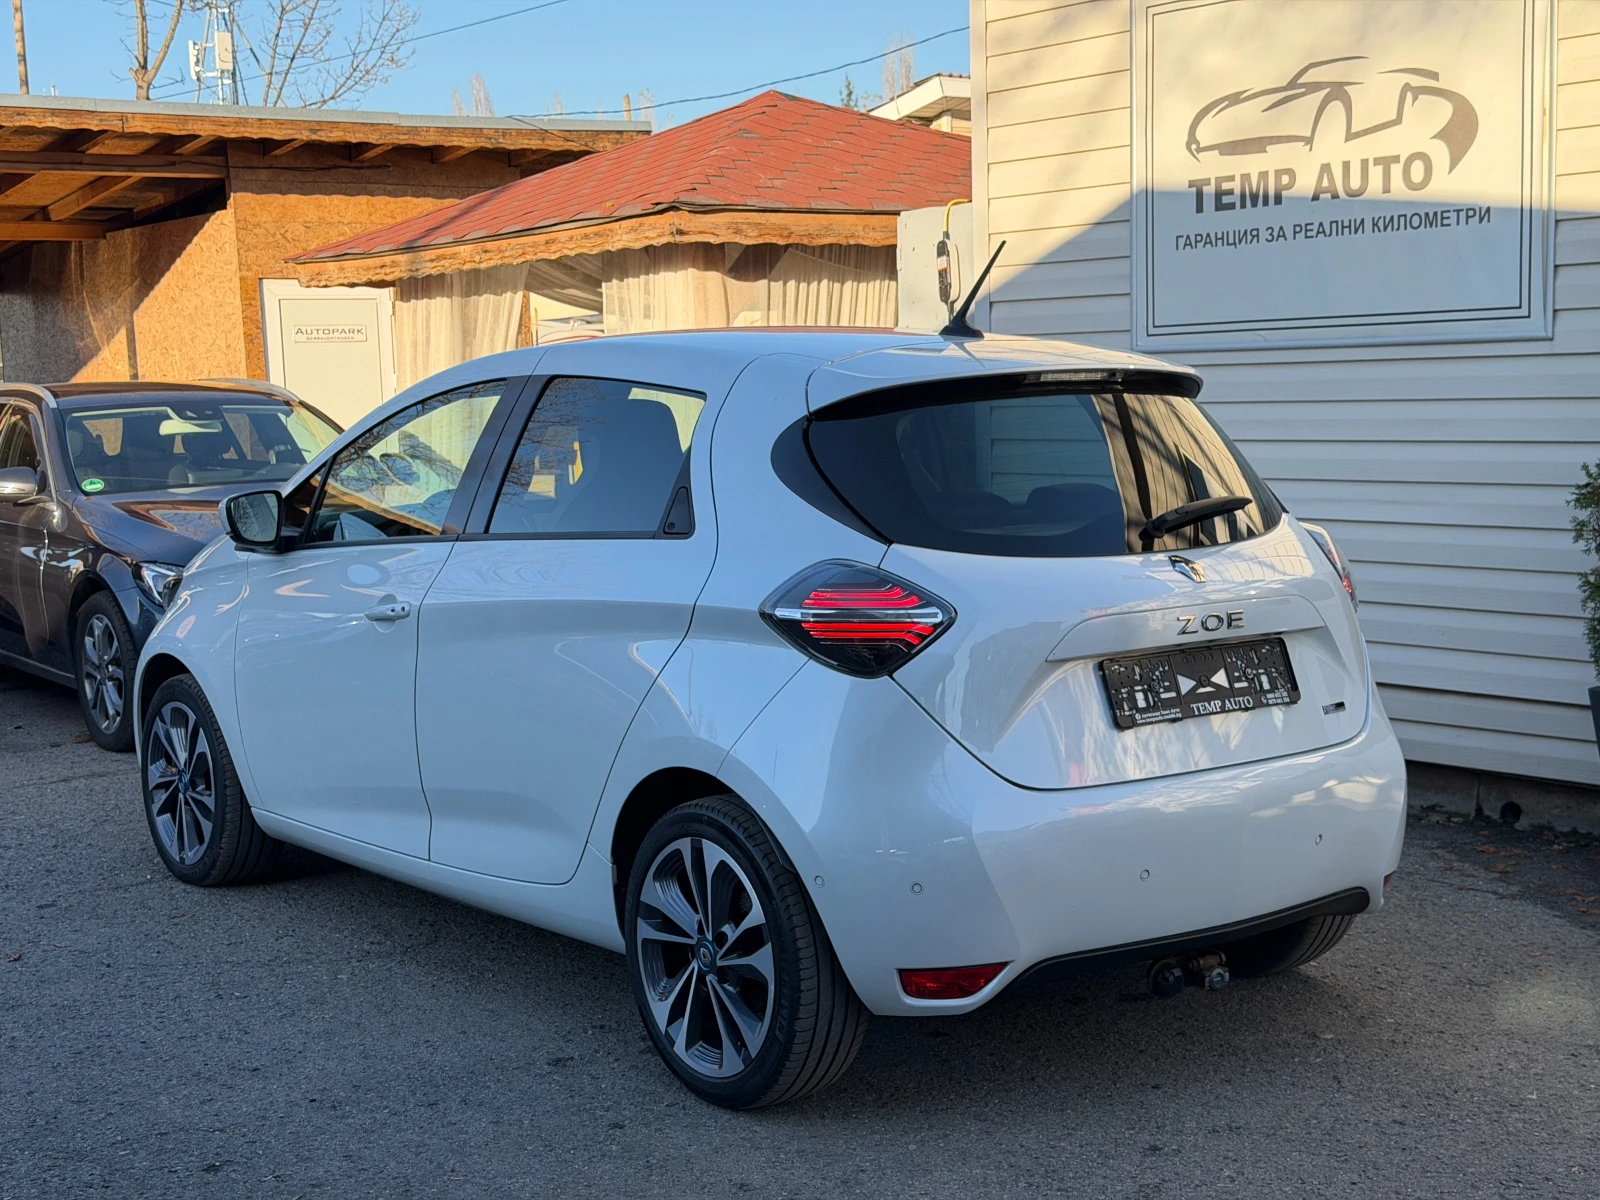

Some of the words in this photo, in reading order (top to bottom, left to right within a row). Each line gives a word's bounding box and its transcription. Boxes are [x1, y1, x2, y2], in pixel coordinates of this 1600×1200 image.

[1188, 167, 1297, 214] TEMP
[1311, 151, 1433, 202] AUTO
[1175, 227, 1260, 252] ГАРАНЦИЯ
[1265, 226, 1288, 243] ЗА
[1292, 217, 1365, 241] РЕАЛНИ
[1371, 206, 1491, 235] КИЛОМЕТРИ
[295, 327, 364, 335] AUTOPARK
[1177, 610, 1245, 635] ZOE
[1190, 700, 1222, 715] TEMP
[1224, 696, 1253, 711] AUTO
